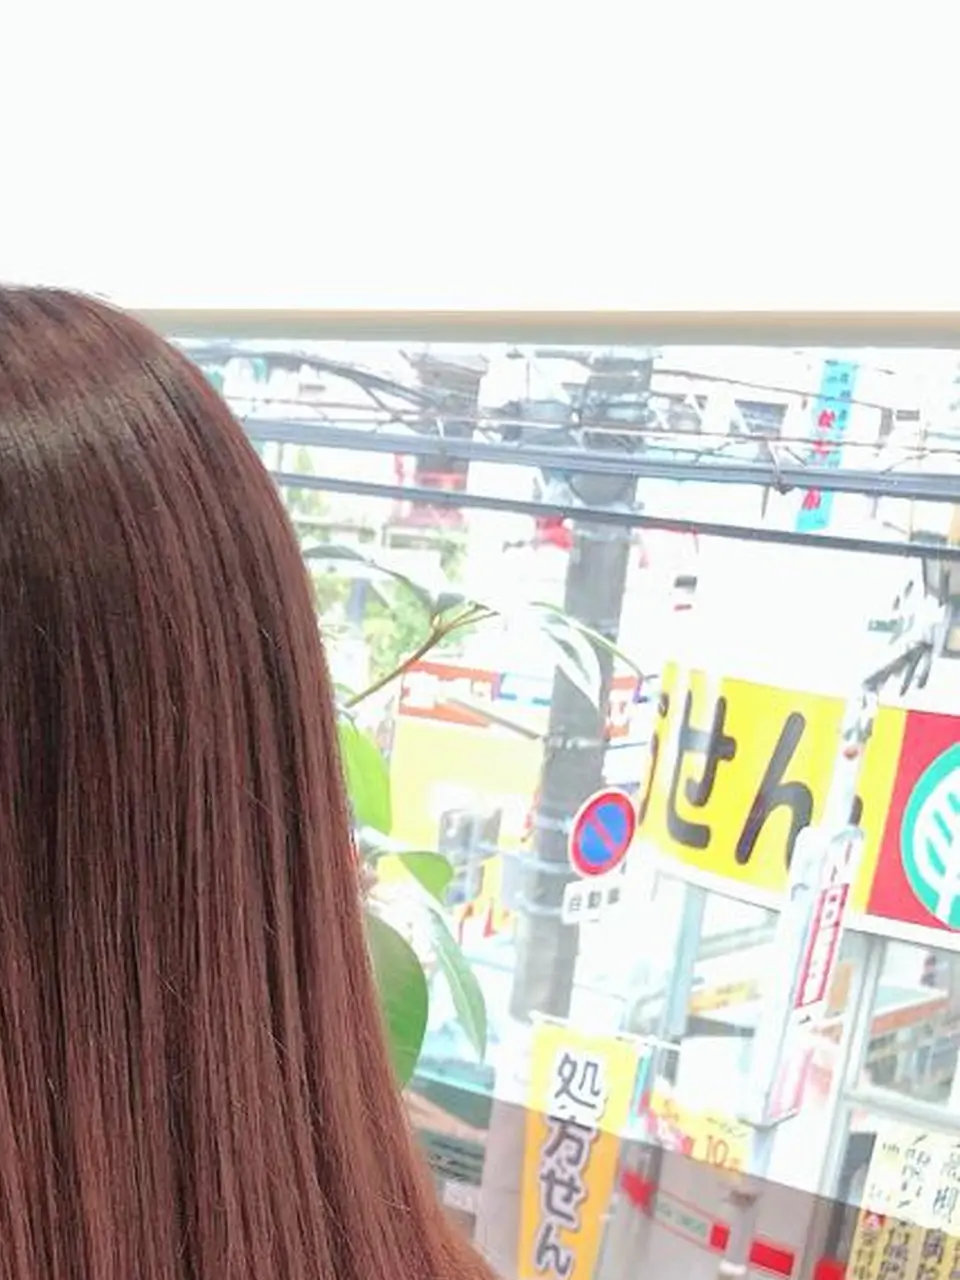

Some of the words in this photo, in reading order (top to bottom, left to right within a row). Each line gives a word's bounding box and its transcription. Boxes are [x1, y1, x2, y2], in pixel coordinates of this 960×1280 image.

[640, 688, 863, 872] せん
[536, 1052, 602, 1277] 処方せん
